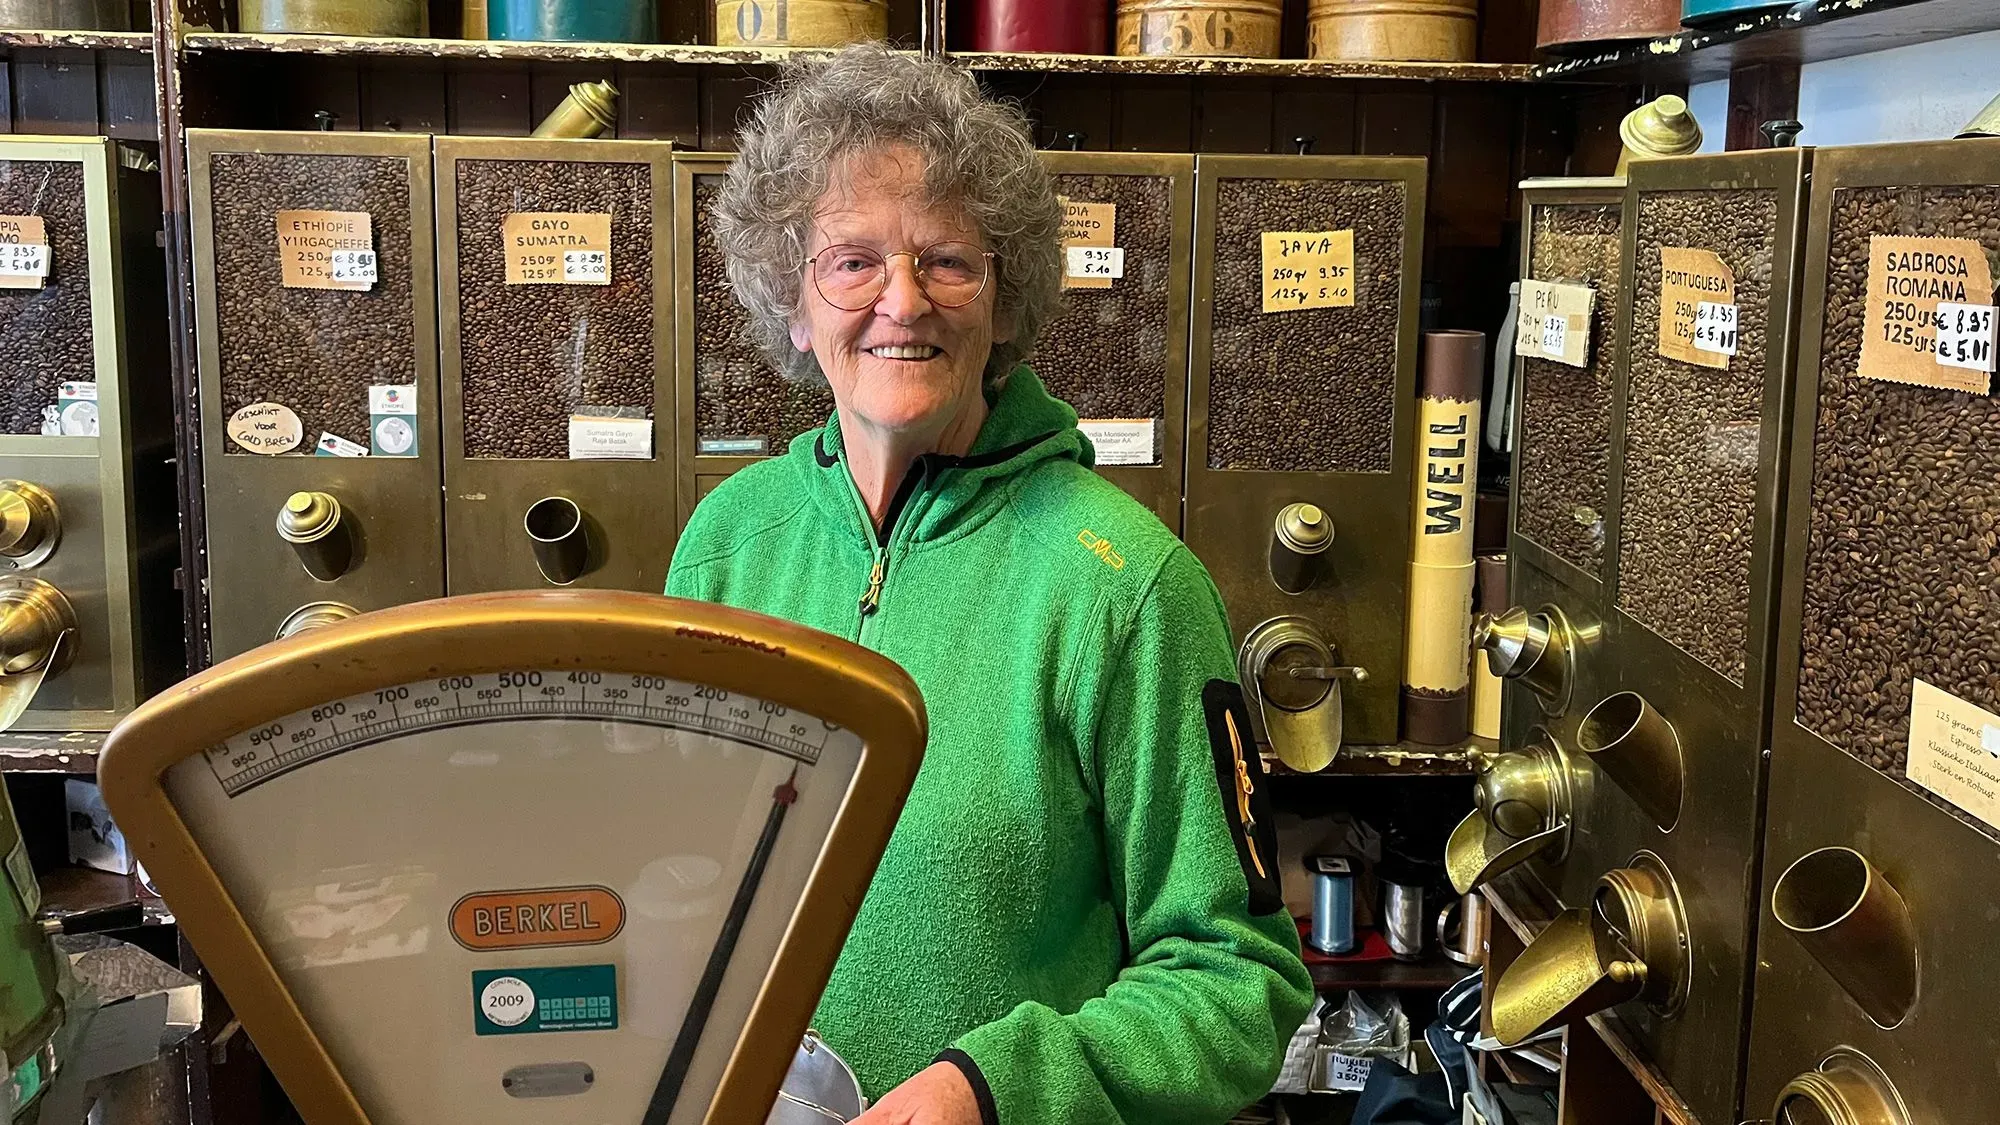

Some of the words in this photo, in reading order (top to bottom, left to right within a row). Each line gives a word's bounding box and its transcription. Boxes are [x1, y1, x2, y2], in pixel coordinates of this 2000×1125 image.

[531, 220, 570, 231] GAYO
[283, 236, 370, 250] YIRGACHEFFE
[516, 235, 589, 247] SUMATRA
[1280, 237, 1333, 257] JAVA
[1084, 263, 1110, 274] 5.10
[1886, 251, 1969, 278] SABROSA
[1665, 269, 1727, 293] PORTUGUESA
[1886, 275, 1967, 302] ROMANA
[1318, 287, 1348, 299] 5.10
[1535, 289, 1560, 309] PERU
[254, 422, 278, 431] VOOR
[237, 430, 261, 446] COLD
[1425, 415, 1467, 535] WELL
[249, 723, 283, 746] 900
[311, 701, 347, 723] 800
[374, 686, 410, 705] 700
[438, 675, 474, 691] 600
[498, 670, 543, 688] 500
[567, 671, 602, 685] 400
[631, 674, 666, 691] 300
[694, 684, 728, 702] 200
[758, 700, 787, 717] 100
[291, 727, 316, 743] 850
[352, 709, 377, 724] 750
[414, 695, 440, 709] 650
[477, 688, 502, 700] 550
[541, 686, 565, 696] 450
[603, 688, 628, 699] 350
[665, 694, 690, 707] 250
[728, 706, 750, 720] 150
[789, 724, 807, 737] 50
[1935, 709, 1950, 723] 125
[1951, 718, 1976, 736] gram
[1950, 733, 1982, 757] Espresso
[1953, 772, 1966, 784] en
[1966, 778, 1995, 800] Robust
[473, 900, 601, 937] BERKEL
[489, 994, 524, 1008] 2009
